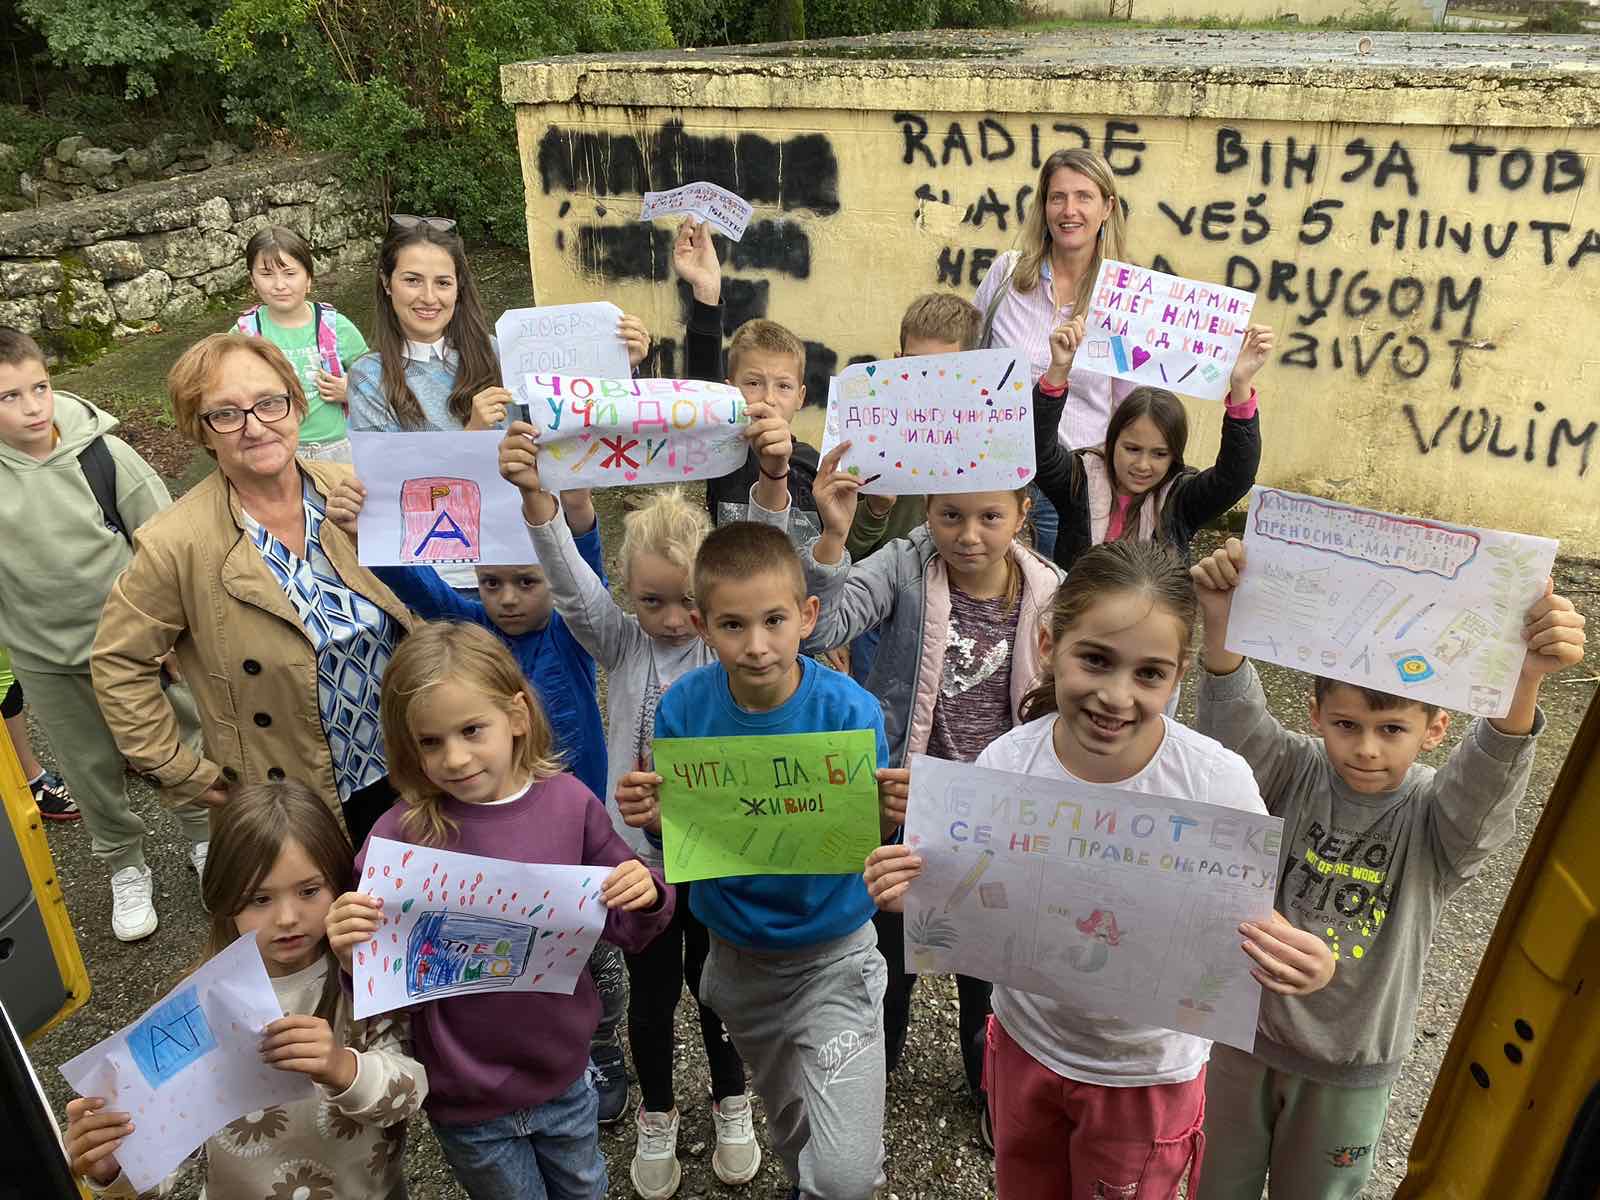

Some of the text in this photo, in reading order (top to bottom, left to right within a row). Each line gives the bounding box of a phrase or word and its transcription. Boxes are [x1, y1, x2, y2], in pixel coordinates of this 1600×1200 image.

[1216, 128, 1318, 188] BIH
[1341, 137, 1419, 196] SA
[1298, 198, 1345, 246] 5
[1096, 287, 1154, 315] НИЈЕГ
[1103, 263, 1153, 295] НЕМА
[1224, 255, 1482, 337] DRUGOM
[1093, 310, 1229, 362] ТАЈА ОД КЊИГА
[534, 375, 699, 400] ЧОВЈЕК
[546, 397, 620, 430] УЧИ
[632, 399, 721, 434] ДОК
[846, 406, 899, 429] ДОБРУ
[905, 407, 946, 426] КЊИГУ
[952, 408, 984, 424] ЧИНИ
[413, 509, 472, 557] А
[672, 752, 876, 790] ЧИТАЈ ДА БИ
[944, 781, 1282, 857] БИБЛИОТЕКЕ
[950, 820, 993, 844] СЕ
[1008, 831, 1050, 855] НЕ
[1067, 836, 1151, 865] ПРАВЕ
